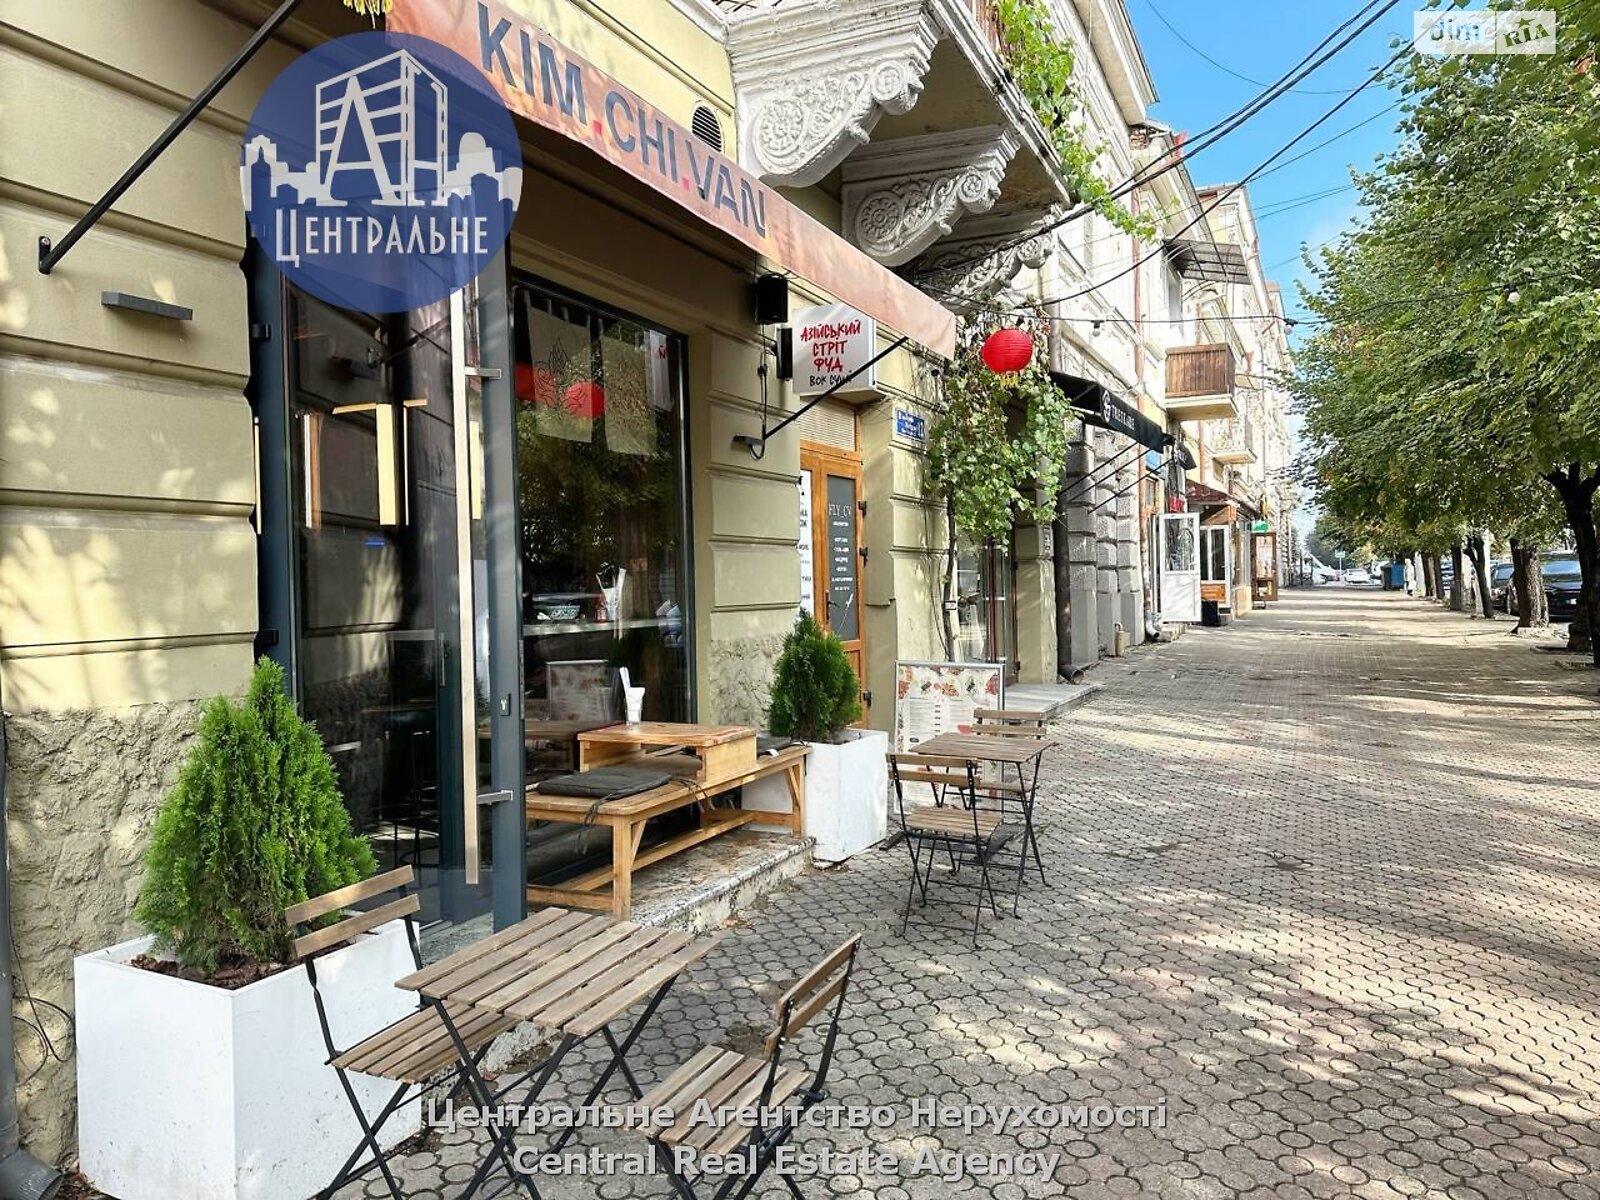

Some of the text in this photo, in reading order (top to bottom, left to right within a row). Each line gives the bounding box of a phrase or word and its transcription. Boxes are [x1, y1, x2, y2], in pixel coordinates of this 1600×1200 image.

[800, 319, 861, 341] АЗІЙСЬКИЙ
[813, 337, 848, 357] СТРІТ
[813, 356, 843, 373] ФУД
[809, 375, 827, 387] ВОК
